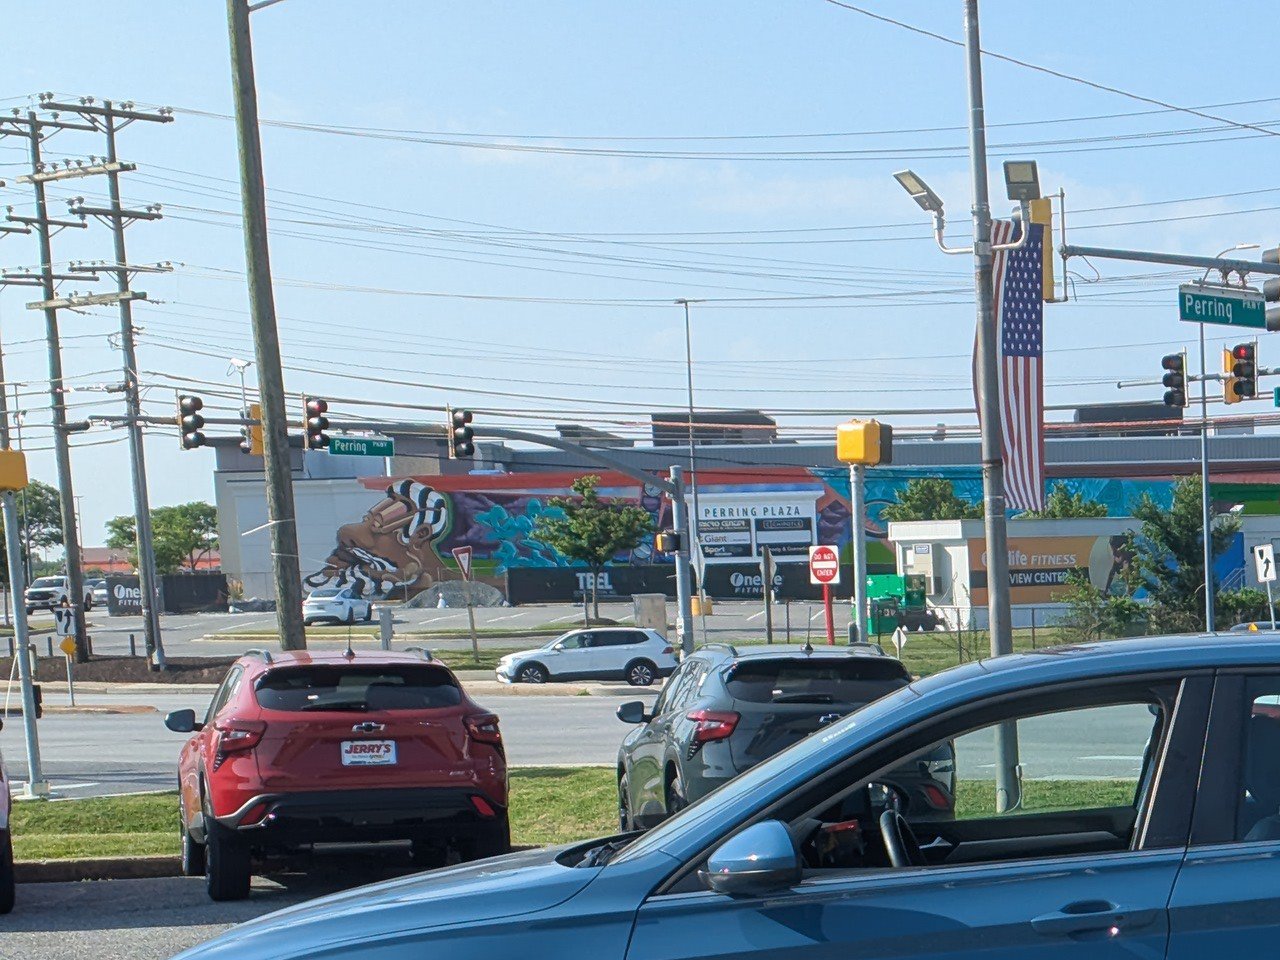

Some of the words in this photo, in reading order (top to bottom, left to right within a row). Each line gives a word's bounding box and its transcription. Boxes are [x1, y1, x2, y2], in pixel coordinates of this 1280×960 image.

[1184, 295, 1233, 323] Perring
[1242, 299, 1261, 309] PKWY
[334, 440, 367, 454] Perring
[704, 508, 757, 517] PERRING
[763, 506, 800, 516] PLAZA
[704, 535, 727, 543] Giant
[704, 545, 726, 554] Sport
[1031, 554, 1076, 565] FITNESS
[730, 572, 783, 587] Onee
[344, 743, 392, 755] JERRY'S
